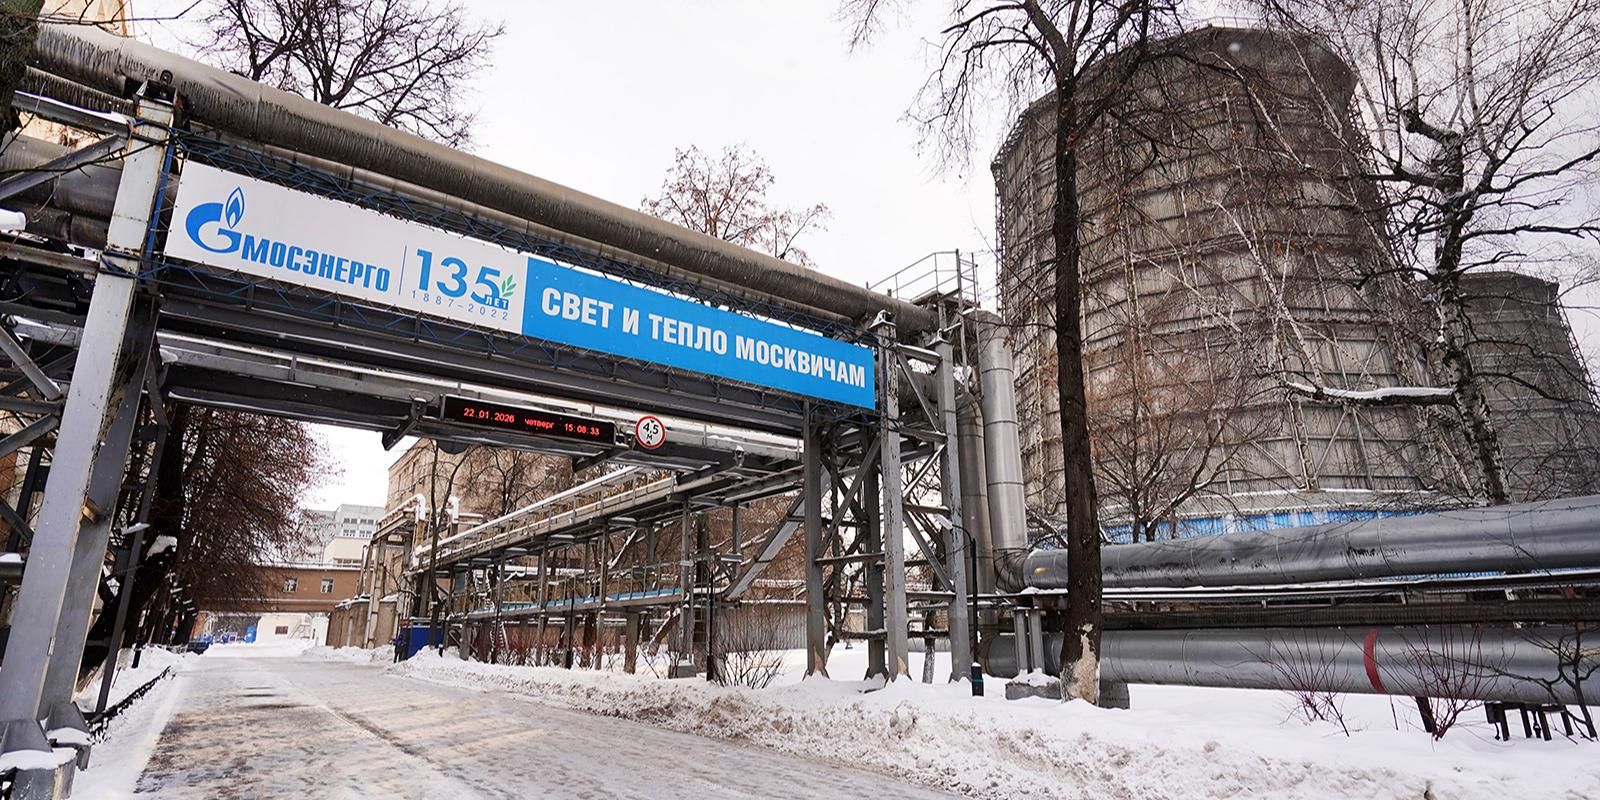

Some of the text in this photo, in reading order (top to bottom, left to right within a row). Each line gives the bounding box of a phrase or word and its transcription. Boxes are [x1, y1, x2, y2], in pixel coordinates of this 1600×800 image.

[241, 233, 391, 292] МОСЭНЕРГО
[417, 249, 501, 305] 135
[484, 295, 509, 310] ЛЕТ
[541, 287, 866, 389] СВЕТ И ТЕПЛО МОСКВИЧАМ
[463, 408, 600, 436] 22.01.2026 четверг 15:08:33
[643, 422, 659, 435] 4,5
